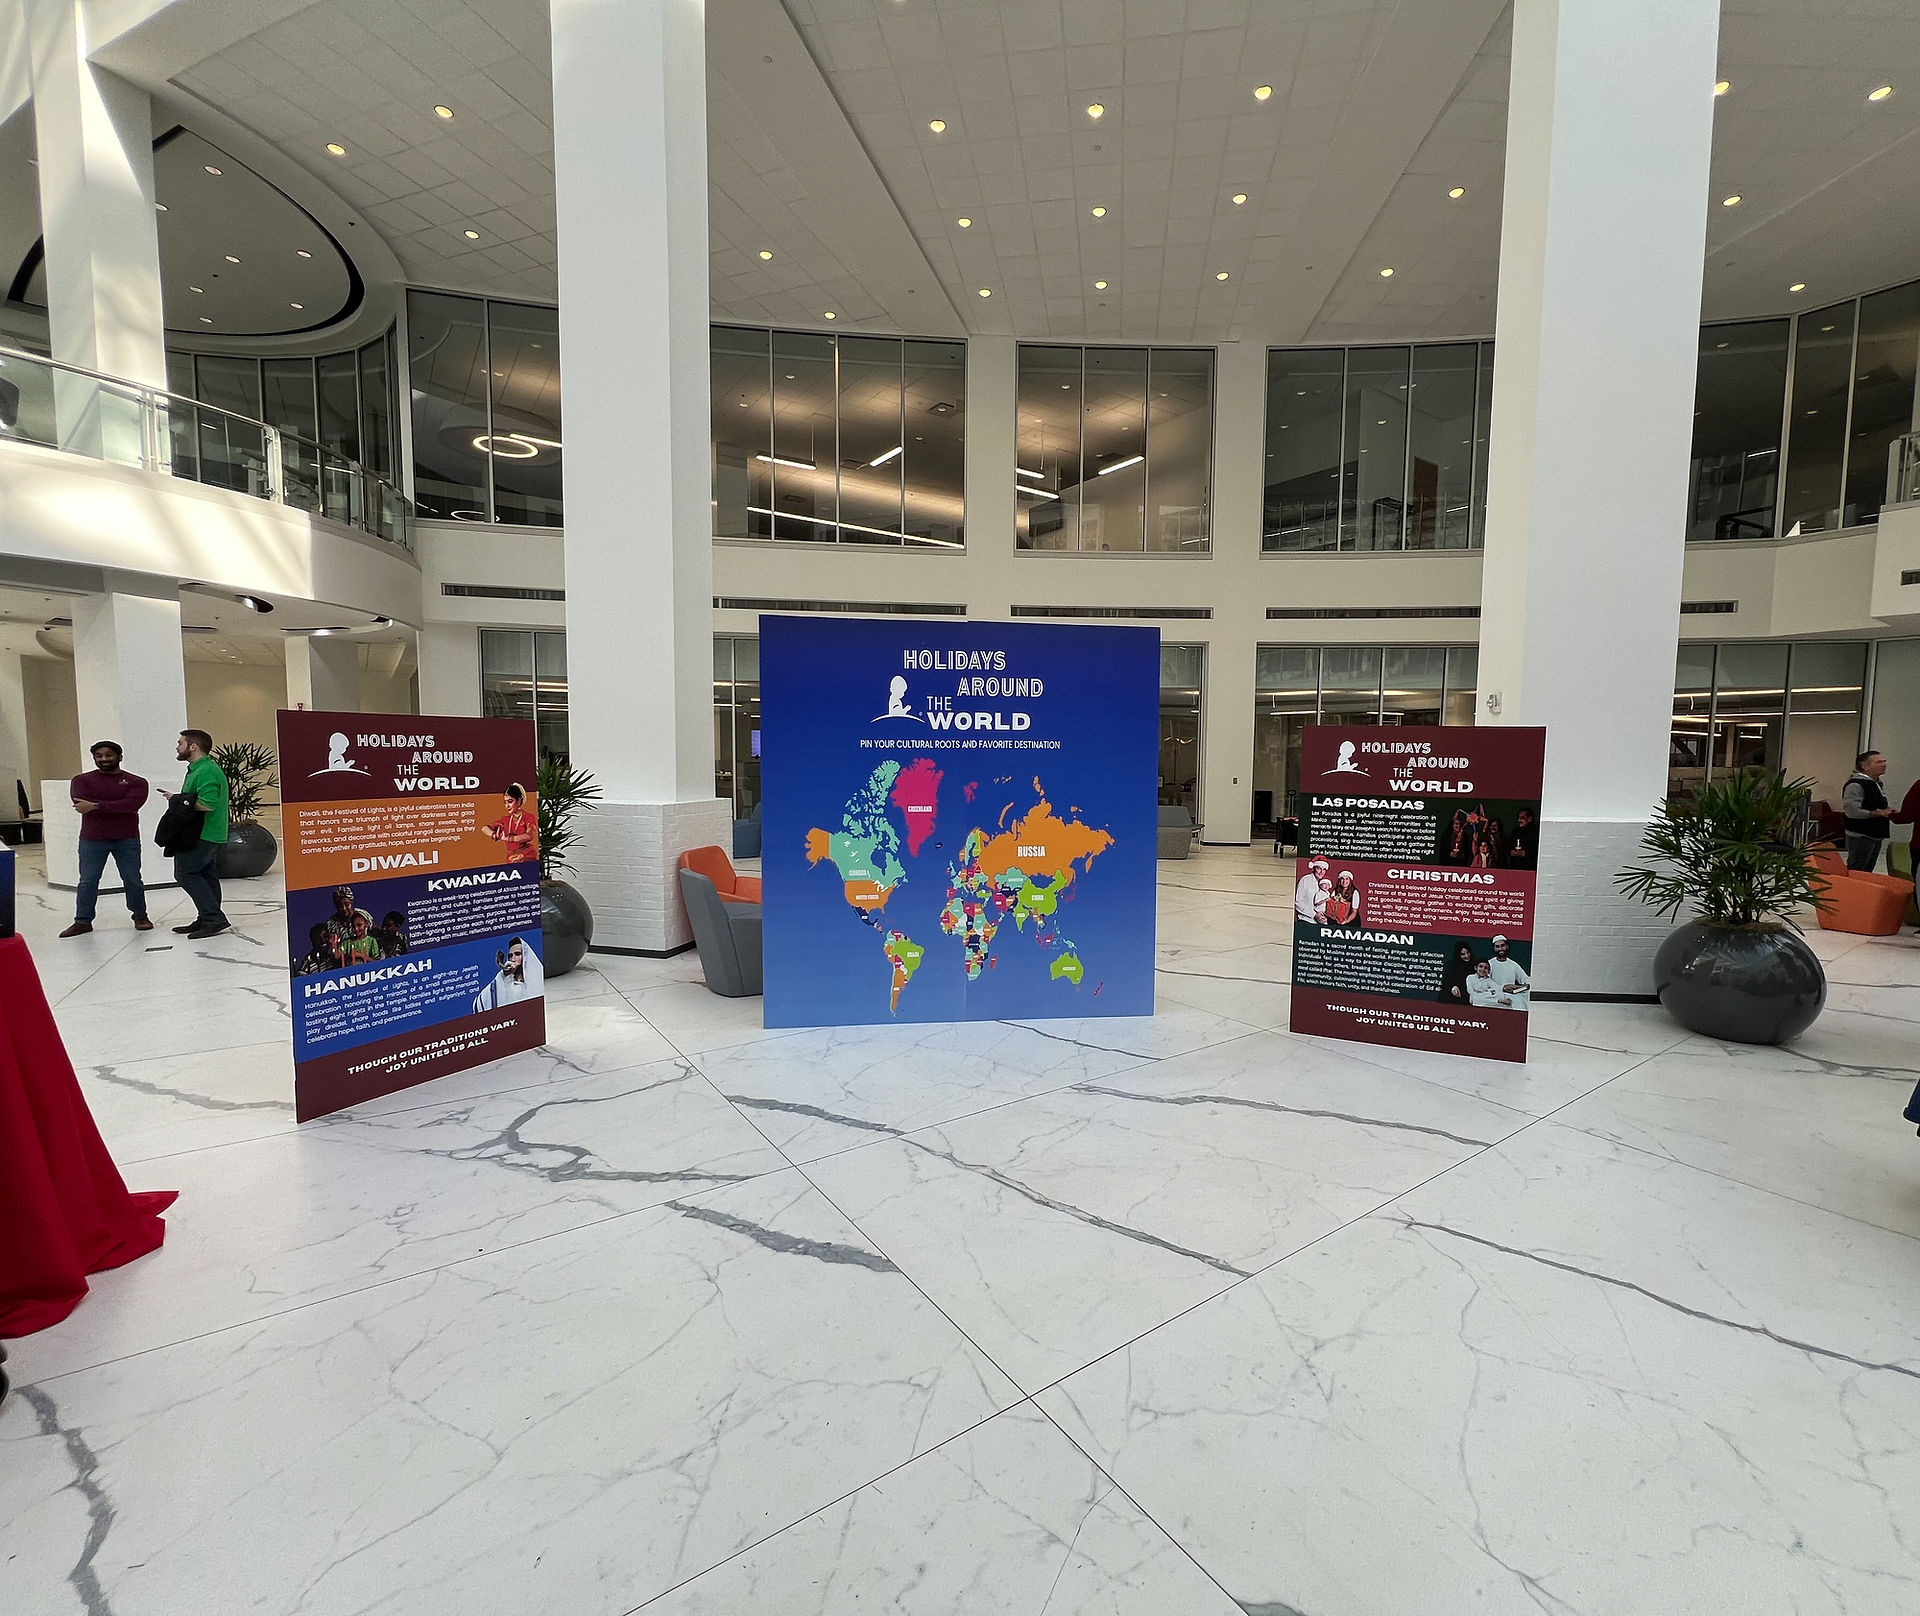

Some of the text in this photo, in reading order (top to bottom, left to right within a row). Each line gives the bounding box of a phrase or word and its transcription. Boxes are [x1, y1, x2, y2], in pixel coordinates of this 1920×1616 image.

[903, 649, 1006, 671] HOLIDAYS
[957, 676, 1044, 698] AROUND
[926, 696, 952, 711] THE
[926, 712, 1031, 731] WORLD
[357, 734, 435, 748] HOLIDAYS
[860, 739, 1061, 750] PIN YOUR CULTURAL ROOTS AND FAVORITE DESTINATION
[1361, 742, 1432, 754] HOLIDAYS
[411, 750, 474, 764] AROUND
[1407, 757, 1470, 769] AROUND
[397, 764, 420, 776] THE
[1393, 767, 1413, 778] THE
[393, 776, 480, 792] WORLD
[1389, 779, 1474, 793] WORLD
[1312, 797, 1425, 810] LAS POSADAS
[1017, 845, 1046, 858] RUSSIA
[351, 850, 440, 873] DIWALI
[427, 869, 522, 892] KWANZAA
[1386, 868, 1495, 885] CHRISTMAS
[1320, 928, 1414, 946] RAMADAN
[304, 958, 433, 998] HANUKKAH
[1326, 1003, 1366, 1015] THOUGH
[1368, 1008, 1389, 1017] OUR
[1390, 1011, 1455, 1025] TRADITIONS
[1355, 1015, 1376, 1024] JOY
[1377, 1018, 1415, 1029] UNITES
[1416, 1023, 1430, 1031] US
[347, 1053, 397, 1075] THOUGH
[399, 1046, 422, 1059] OUR
[423, 1026, 488, 1052] TRADITIONS
[385, 1060, 407, 1073] JOY
[410, 1047, 449, 1065] UNITES
[451, 1043, 464, 1053] US
